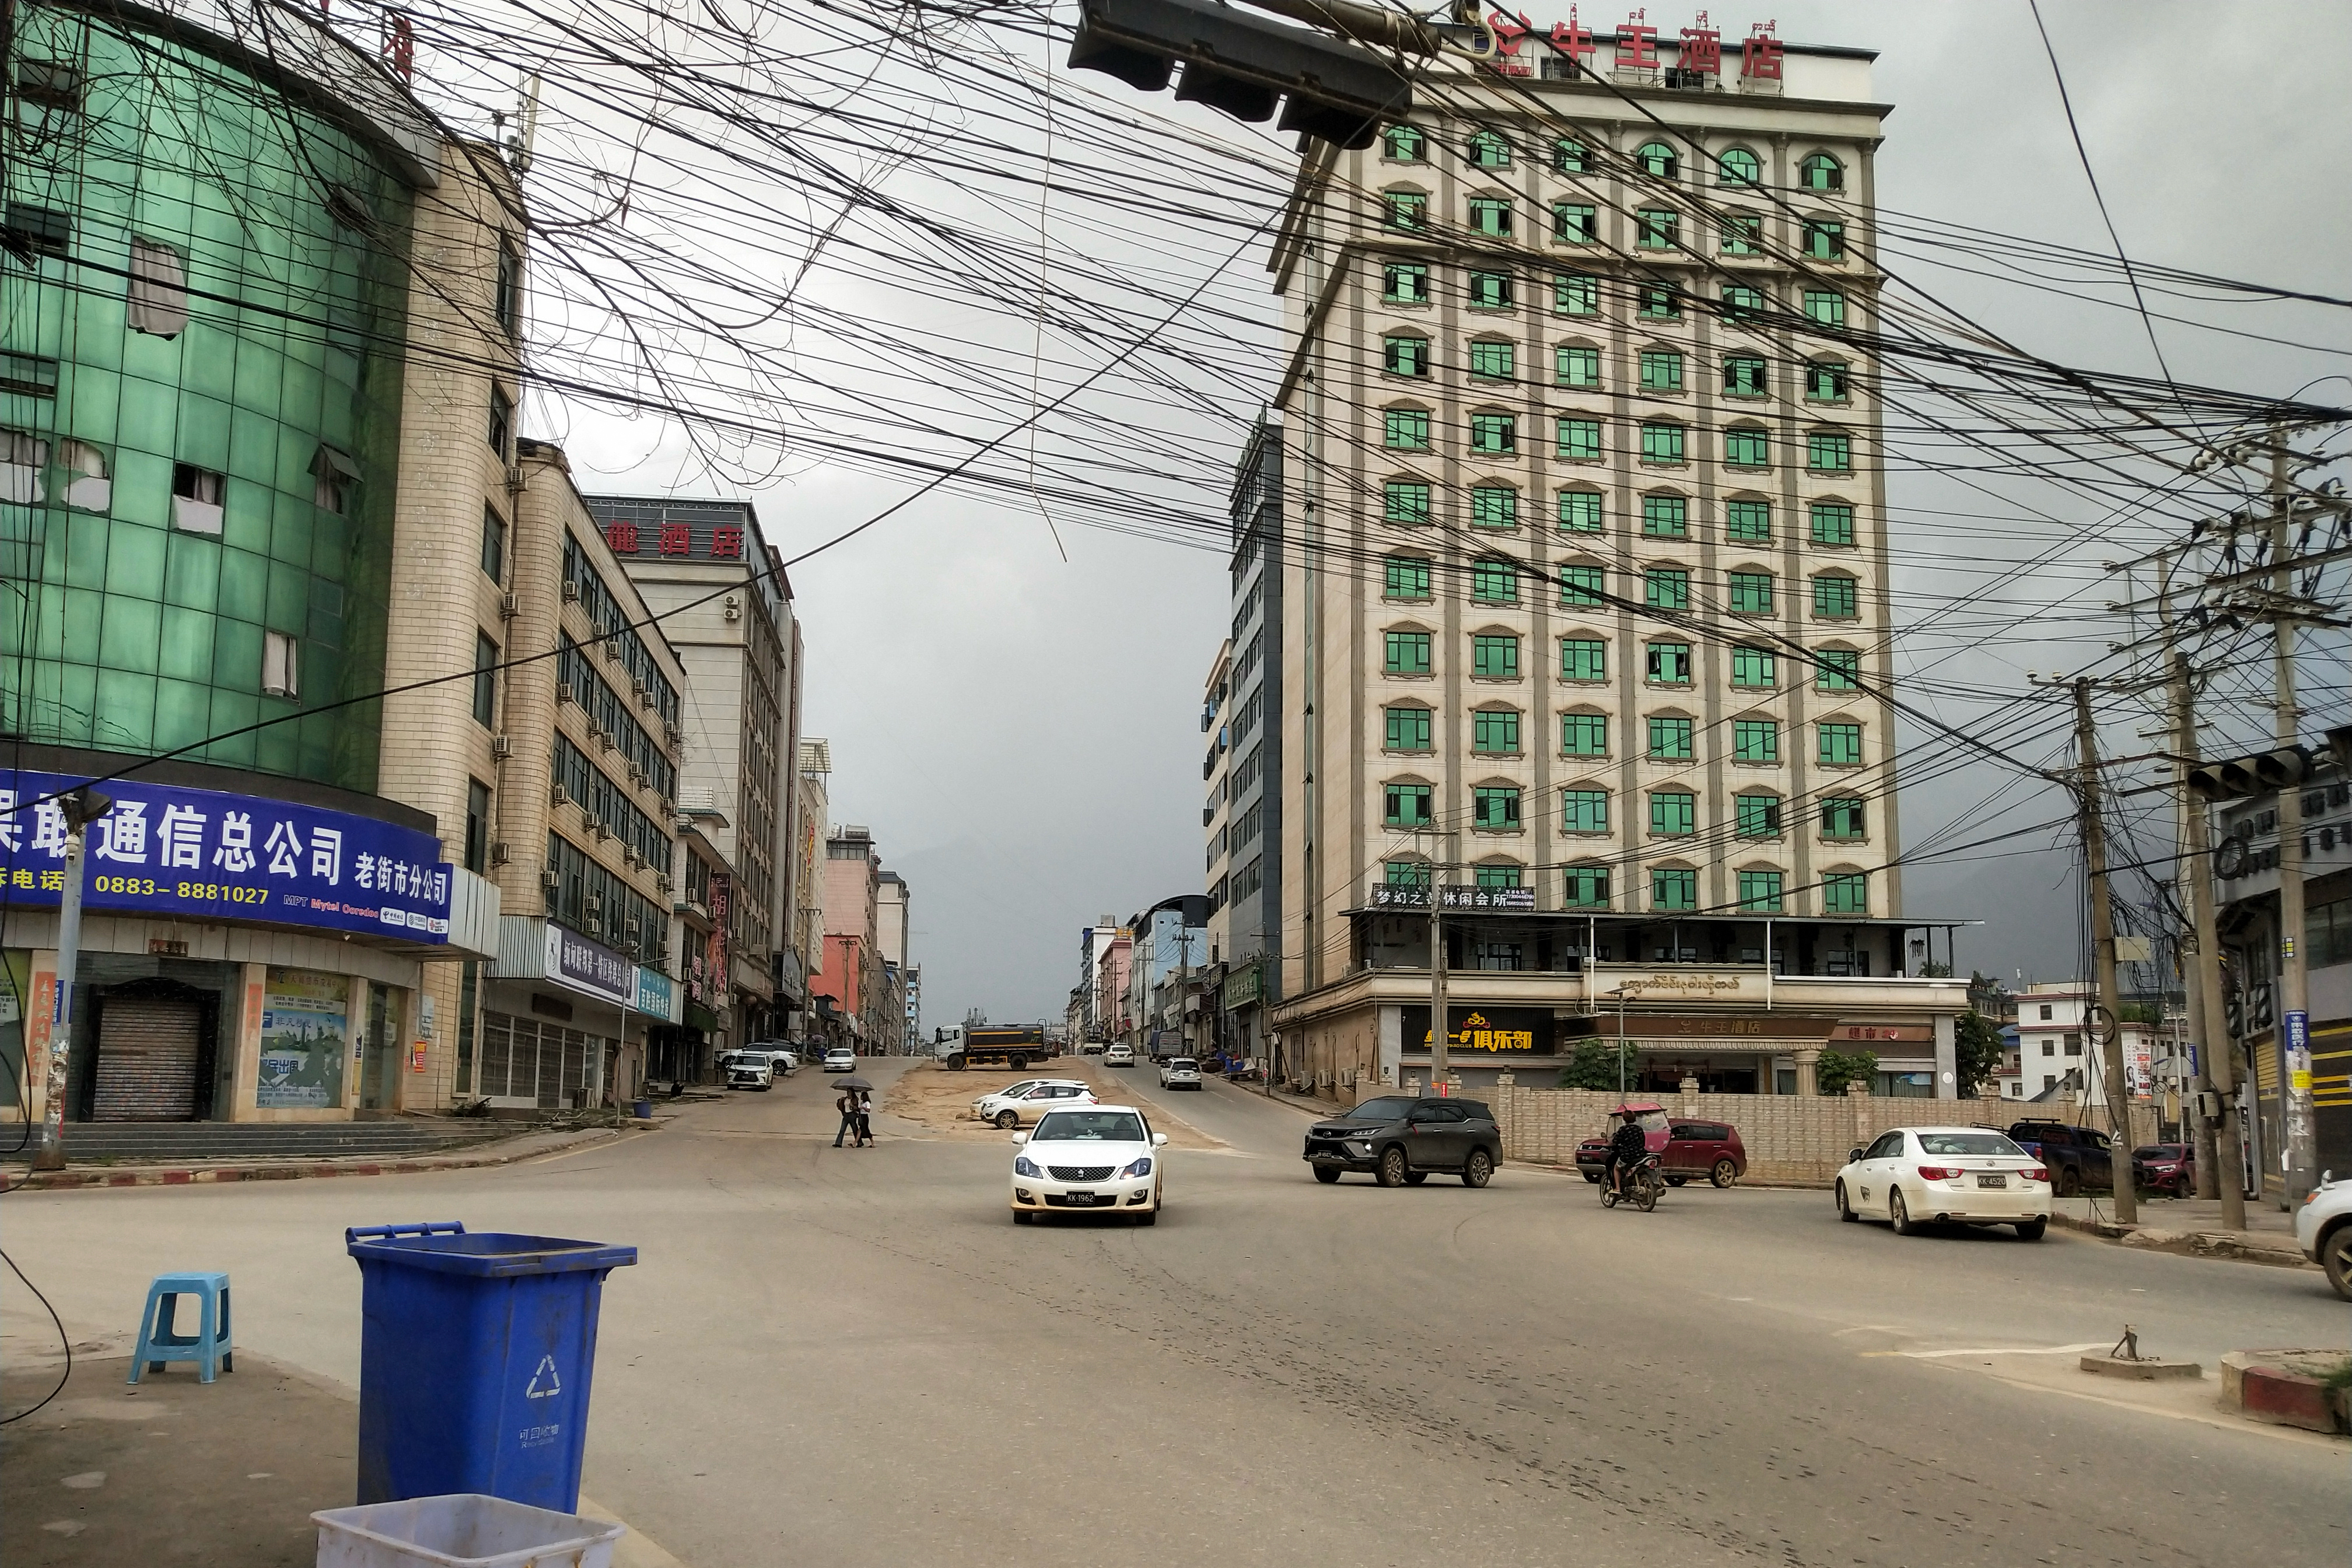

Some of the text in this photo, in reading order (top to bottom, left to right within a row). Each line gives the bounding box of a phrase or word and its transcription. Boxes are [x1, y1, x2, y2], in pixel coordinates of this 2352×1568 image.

[1550, 20, 1784, 80] 牛王酒店
[355, 851, 447, 905] 老街市分公司
[284, 895, 379, 918] MPT Mytel Ooredoo
[1700, 1020, 1760, 1034] 牛王酒店
[1424, 1030, 1532, 1052] 星一号俱乐部
